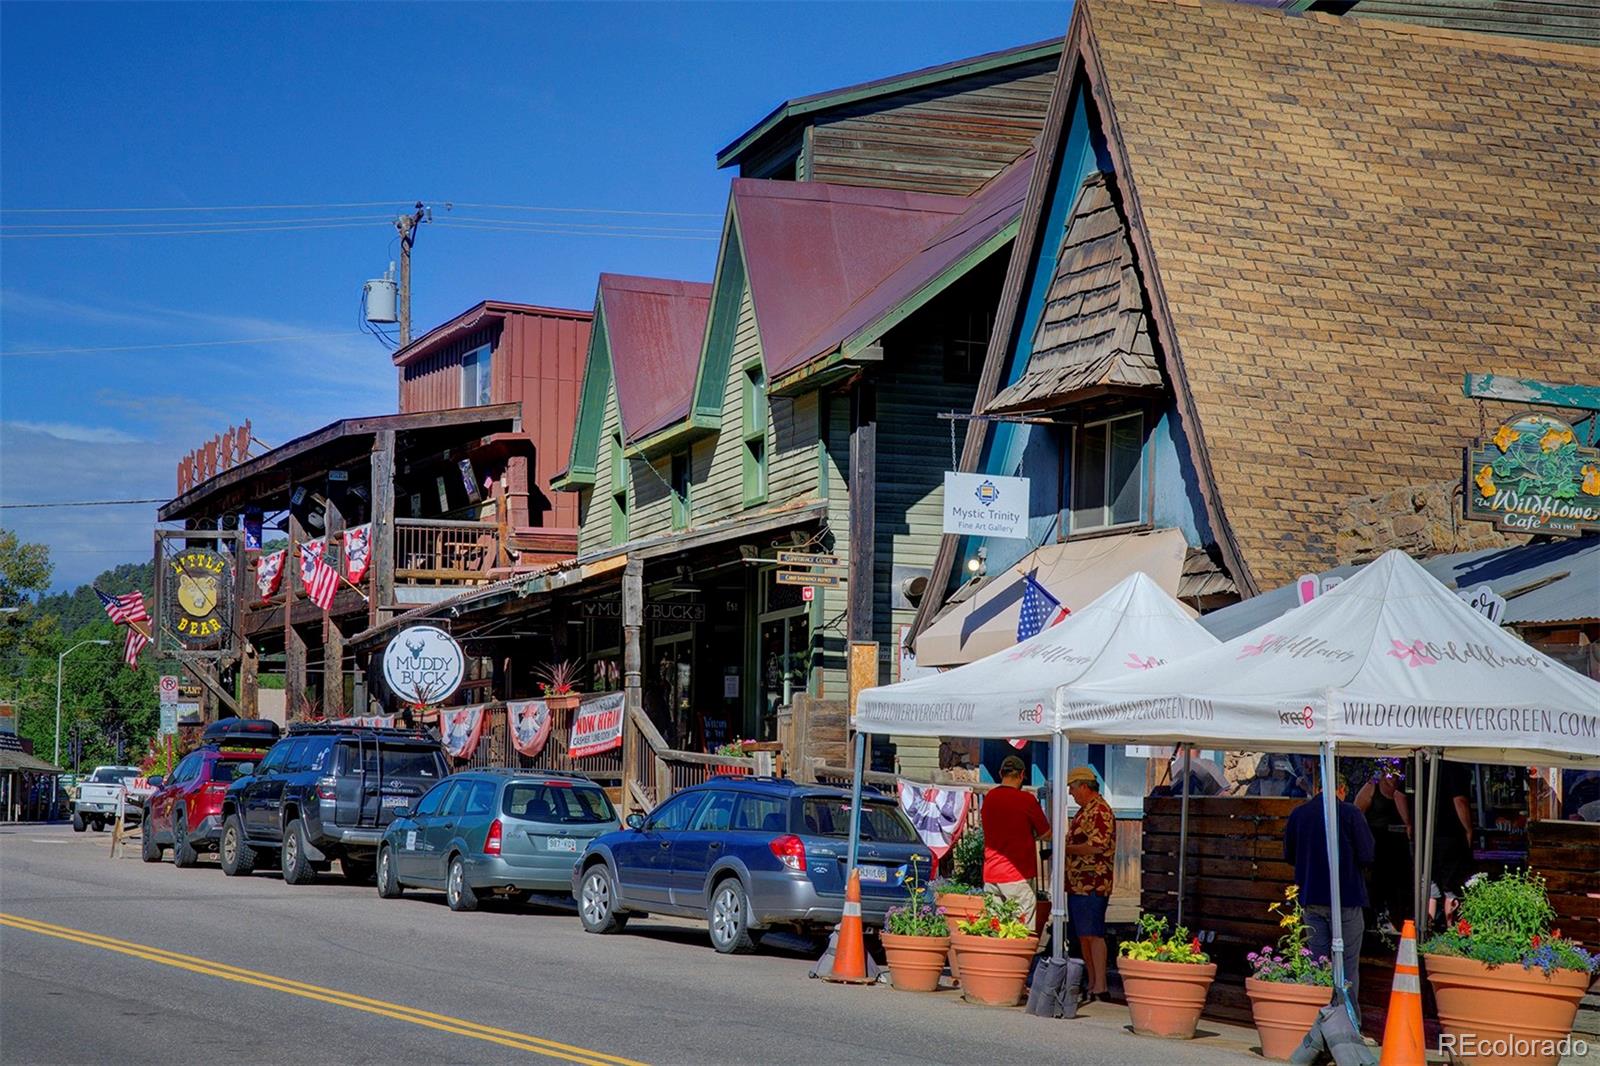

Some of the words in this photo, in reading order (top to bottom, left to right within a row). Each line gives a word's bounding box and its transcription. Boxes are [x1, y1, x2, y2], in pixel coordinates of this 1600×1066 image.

[952, 506, 985, 520] Mystic
[988, 509, 1020, 524] Trinity
[1503, 512, 1541, 530] Cafe
[958, 521, 973, 530] Fine
[975, 522, 986, 530] Art
[988, 523, 1014, 533] Gallery
[170, 554, 225, 574] LITTLE
[651, 603, 694, 619] BUCK
[177, 617, 222, 635] BEAR
[396, 656, 453, 671] MUDDY
[401, 671, 447, 686] BUCK
[864, 701, 976, 722] WILDFLOWEREVERGREEN.COM
[1343, 702, 1597, 738] WILDFLOWEREVERGREEN.COM
[576, 714, 596, 735] NOW
